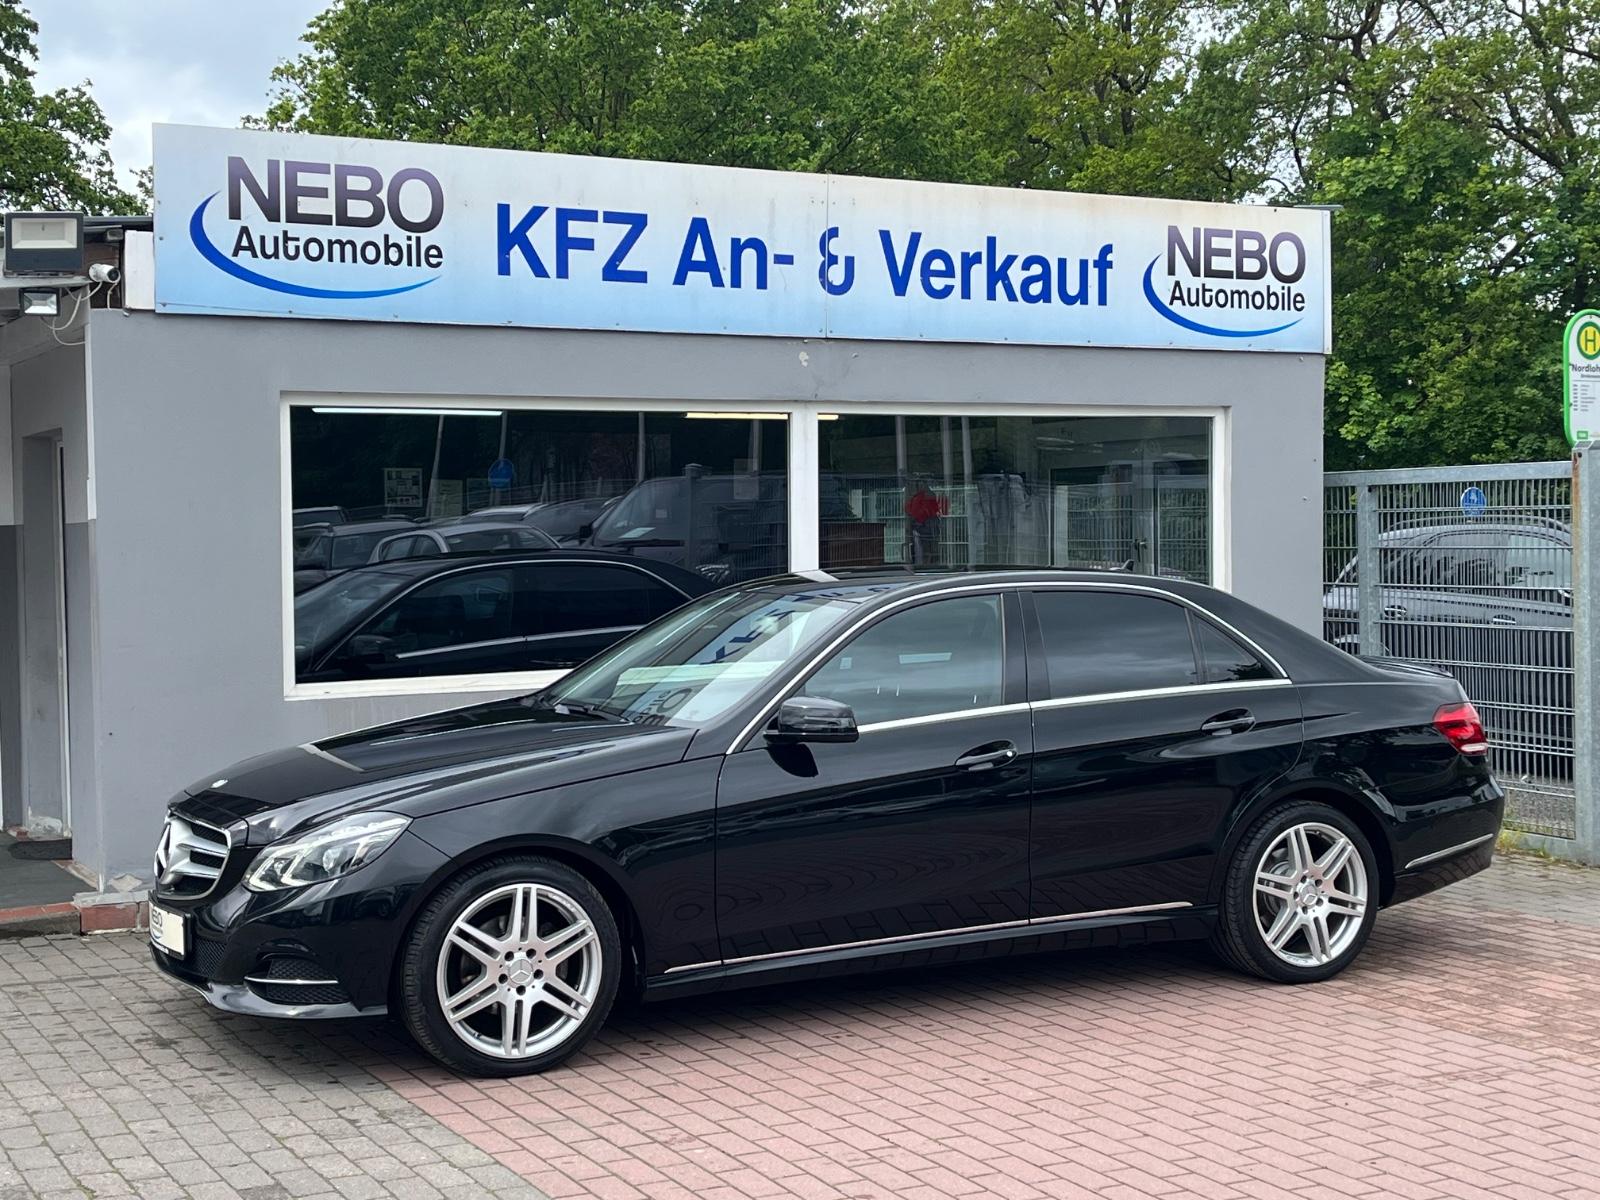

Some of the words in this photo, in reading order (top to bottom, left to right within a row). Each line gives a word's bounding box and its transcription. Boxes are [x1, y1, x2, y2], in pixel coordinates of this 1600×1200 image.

[228, 156, 444, 234] NEBO
[232, 226, 444, 269] Automobile
[497, 203, 648, 284] KFZ
[673, 216, 794, 290] An-
[818, 227, 855, 297] &
[879, 230, 1113, 307] Verkauf
[1167, 225, 1306, 284] NEBO
[1168, 280, 1306, 312] Automobile
[1585, 329, 1596, 352] H
